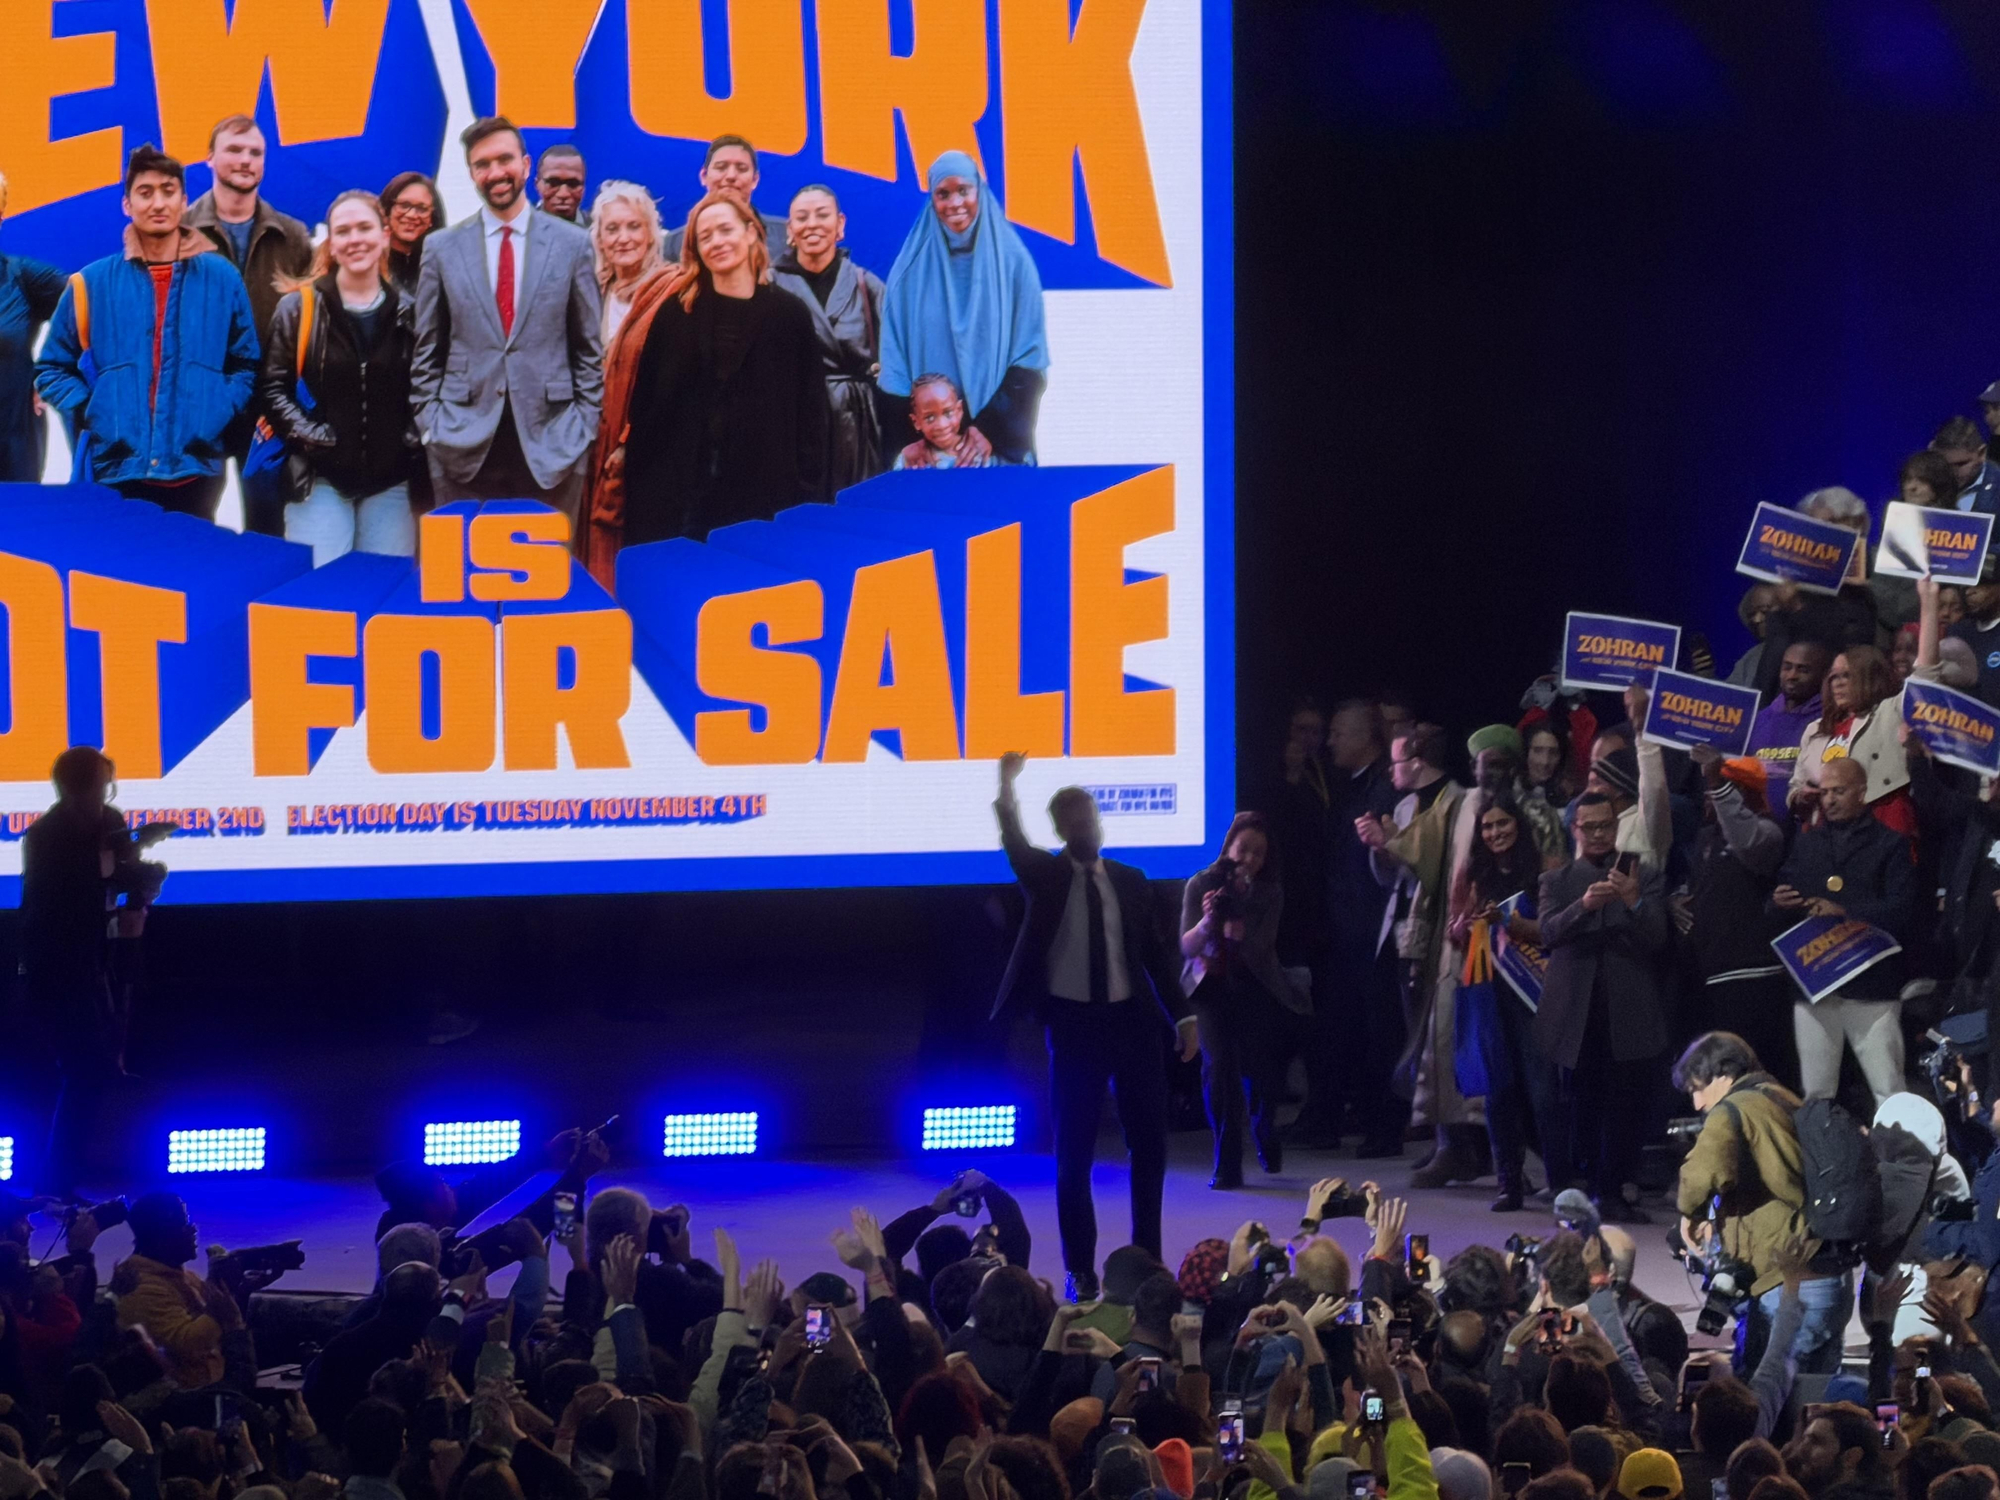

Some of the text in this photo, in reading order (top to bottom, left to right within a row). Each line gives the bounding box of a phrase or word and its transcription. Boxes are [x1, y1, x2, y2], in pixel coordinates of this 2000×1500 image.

[1924, 528, 1978, 550] HRAN
[420, 513, 571, 602] IS
[248, 602, 633, 777] FOR
[695, 463, 1176, 766] SALE
[1577, 635, 1665, 662] ZOHRAN
[1661, 691, 1743, 726] ZOHRAN
[1912, 700, 1994, 742] ZOHRAN
[218, 805, 265, 829] 2ND
[287, 793, 768, 828] ELECTION DAY IS TUESDAY NOVEMBER 4TH
